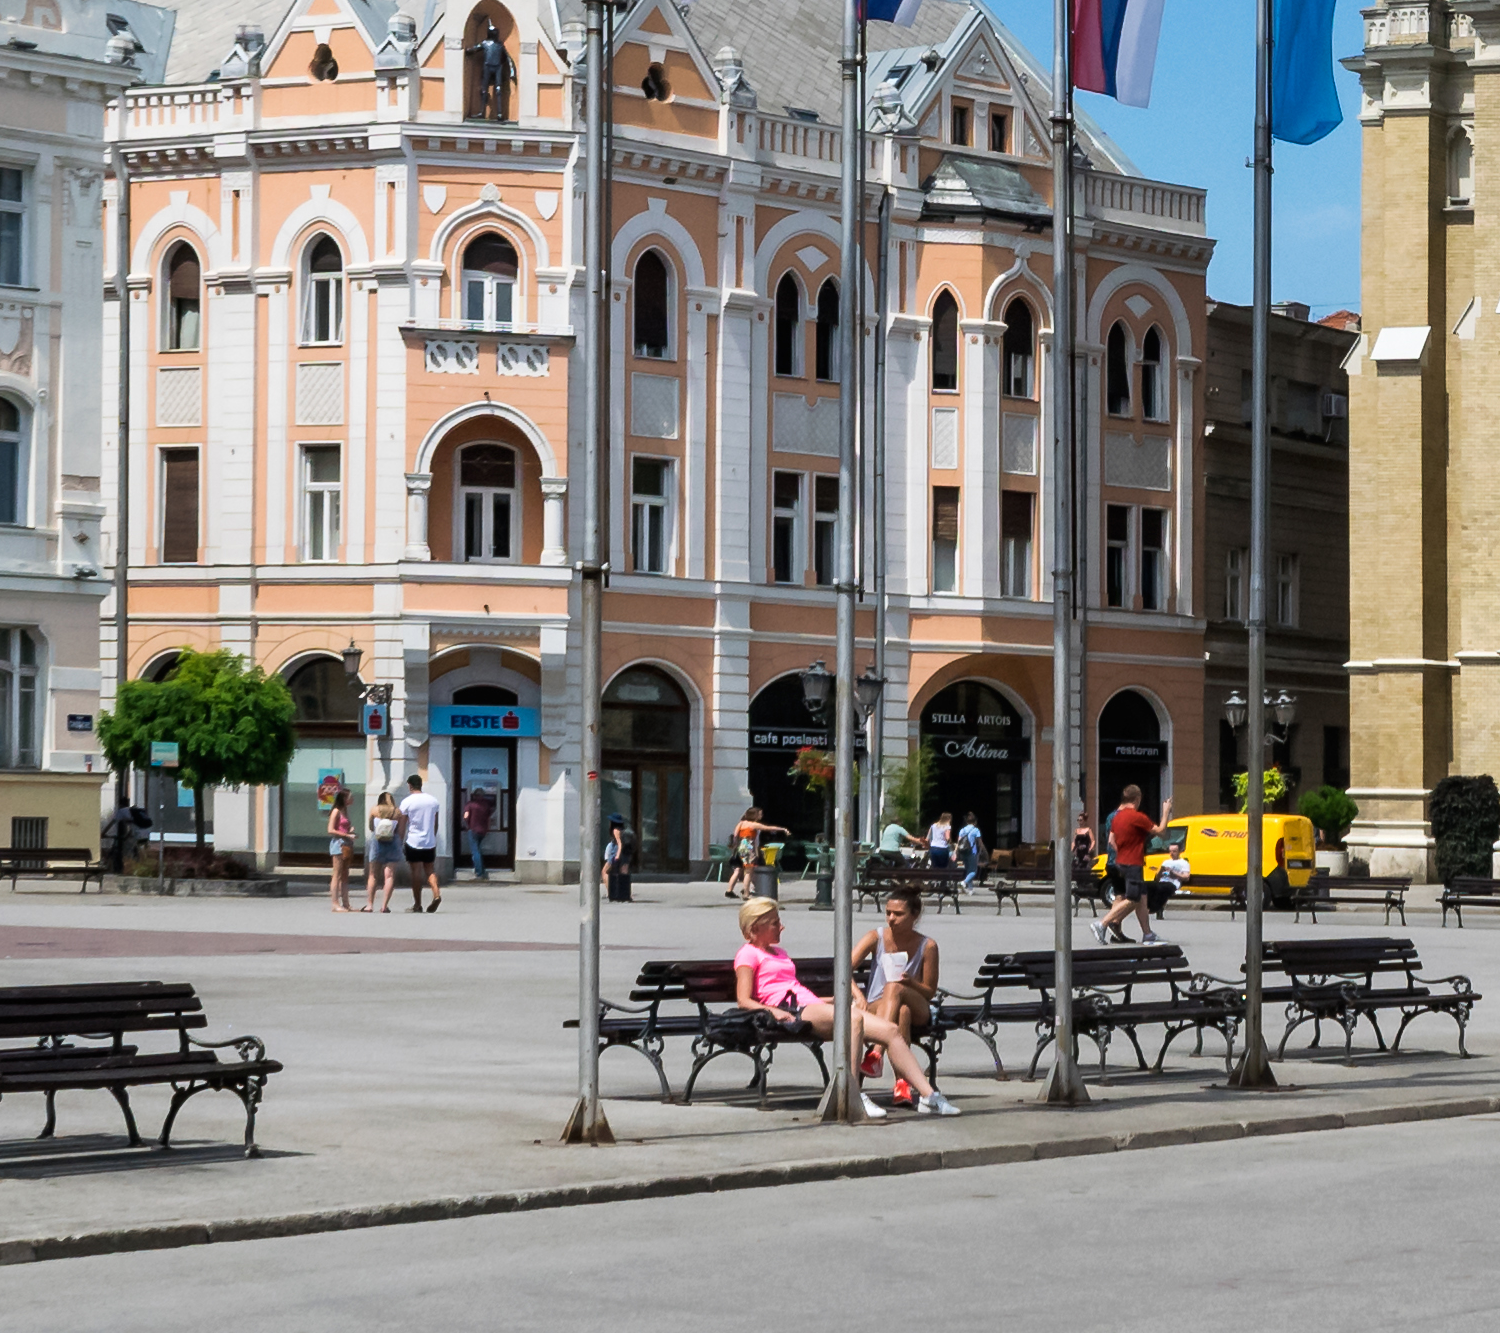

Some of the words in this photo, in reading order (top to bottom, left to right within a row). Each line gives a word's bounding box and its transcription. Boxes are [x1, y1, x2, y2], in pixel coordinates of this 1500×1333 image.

[450, 714, 500, 729] ERSTE
[932, 713, 966, 724] STELLA
[977, 715, 1011, 726] ARTOIS
[754, 732, 778, 745] cafe
[1115, 745, 1159, 756] restoran
